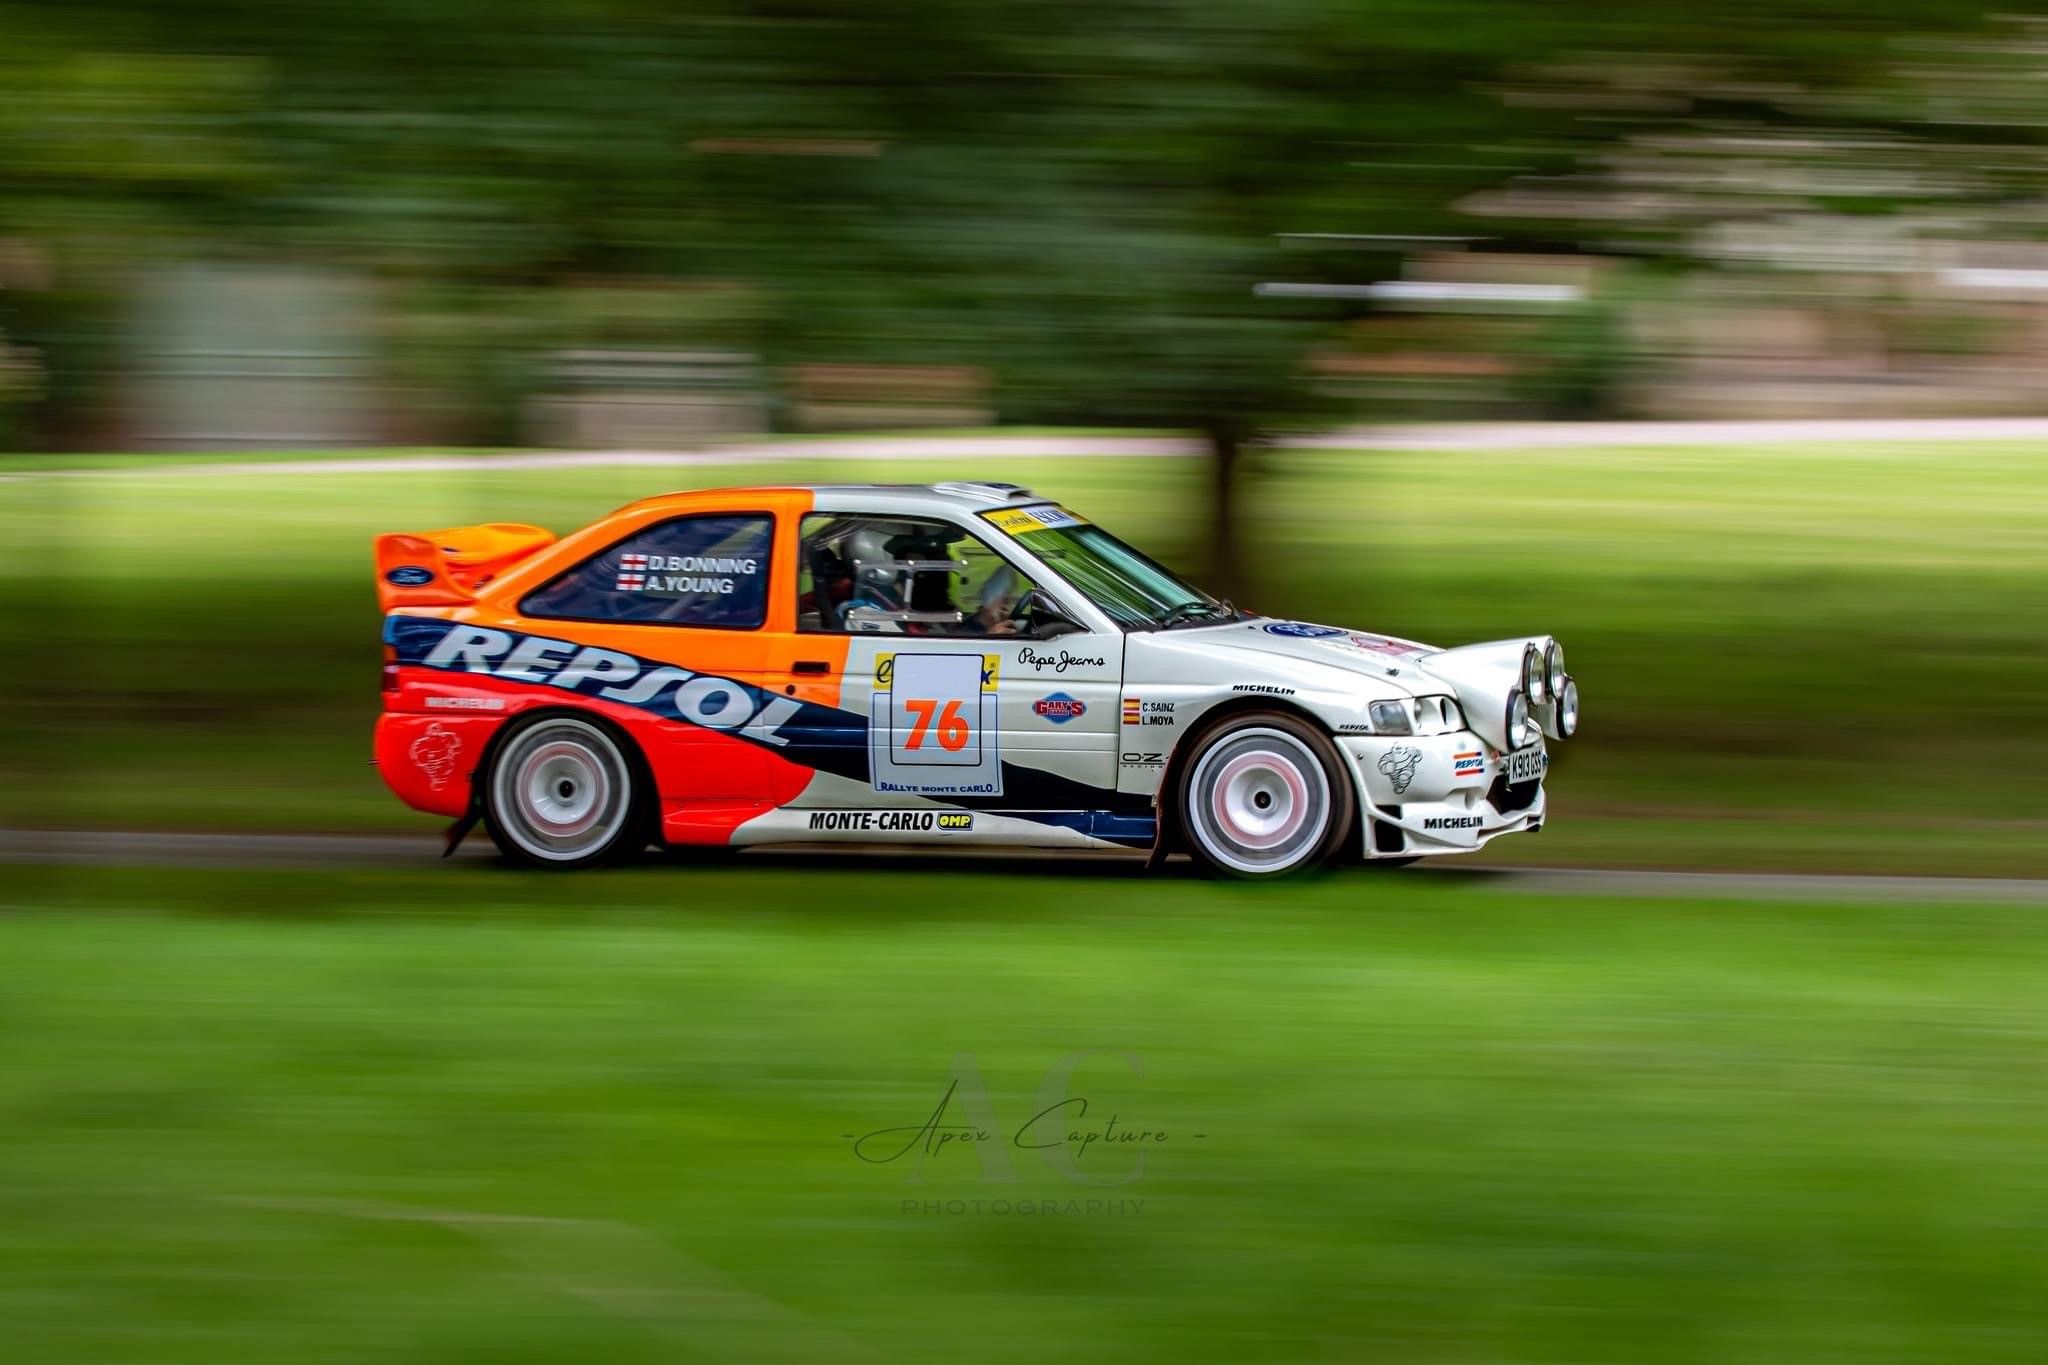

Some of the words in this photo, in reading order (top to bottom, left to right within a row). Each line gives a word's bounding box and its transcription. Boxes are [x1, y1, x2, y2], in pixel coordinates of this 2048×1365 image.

[648, 555, 757, 575] D.BONNING
[645, 575, 734, 594] A.YOUNG
[1018, 647, 1056, 671] Pepe
[1056, 650, 1106, 673] Jeans
[422, 625, 804, 747] REPSOL
[1232, 684, 1296, 696] MICHELIN
[903, 698, 970, 752] 76
[1142, 715, 1175, 726] L.MOYA
[880, 781, 919, 792] RALLYE
[921, 785, 957, 793] MONTE
[959, 783, 993, 793] CARLO
[809, 812, 934, 831] MONTE-CARLO
[939, 815, 971, 827] OMP
[1423, 816, 1484, 829] MICHELIN
